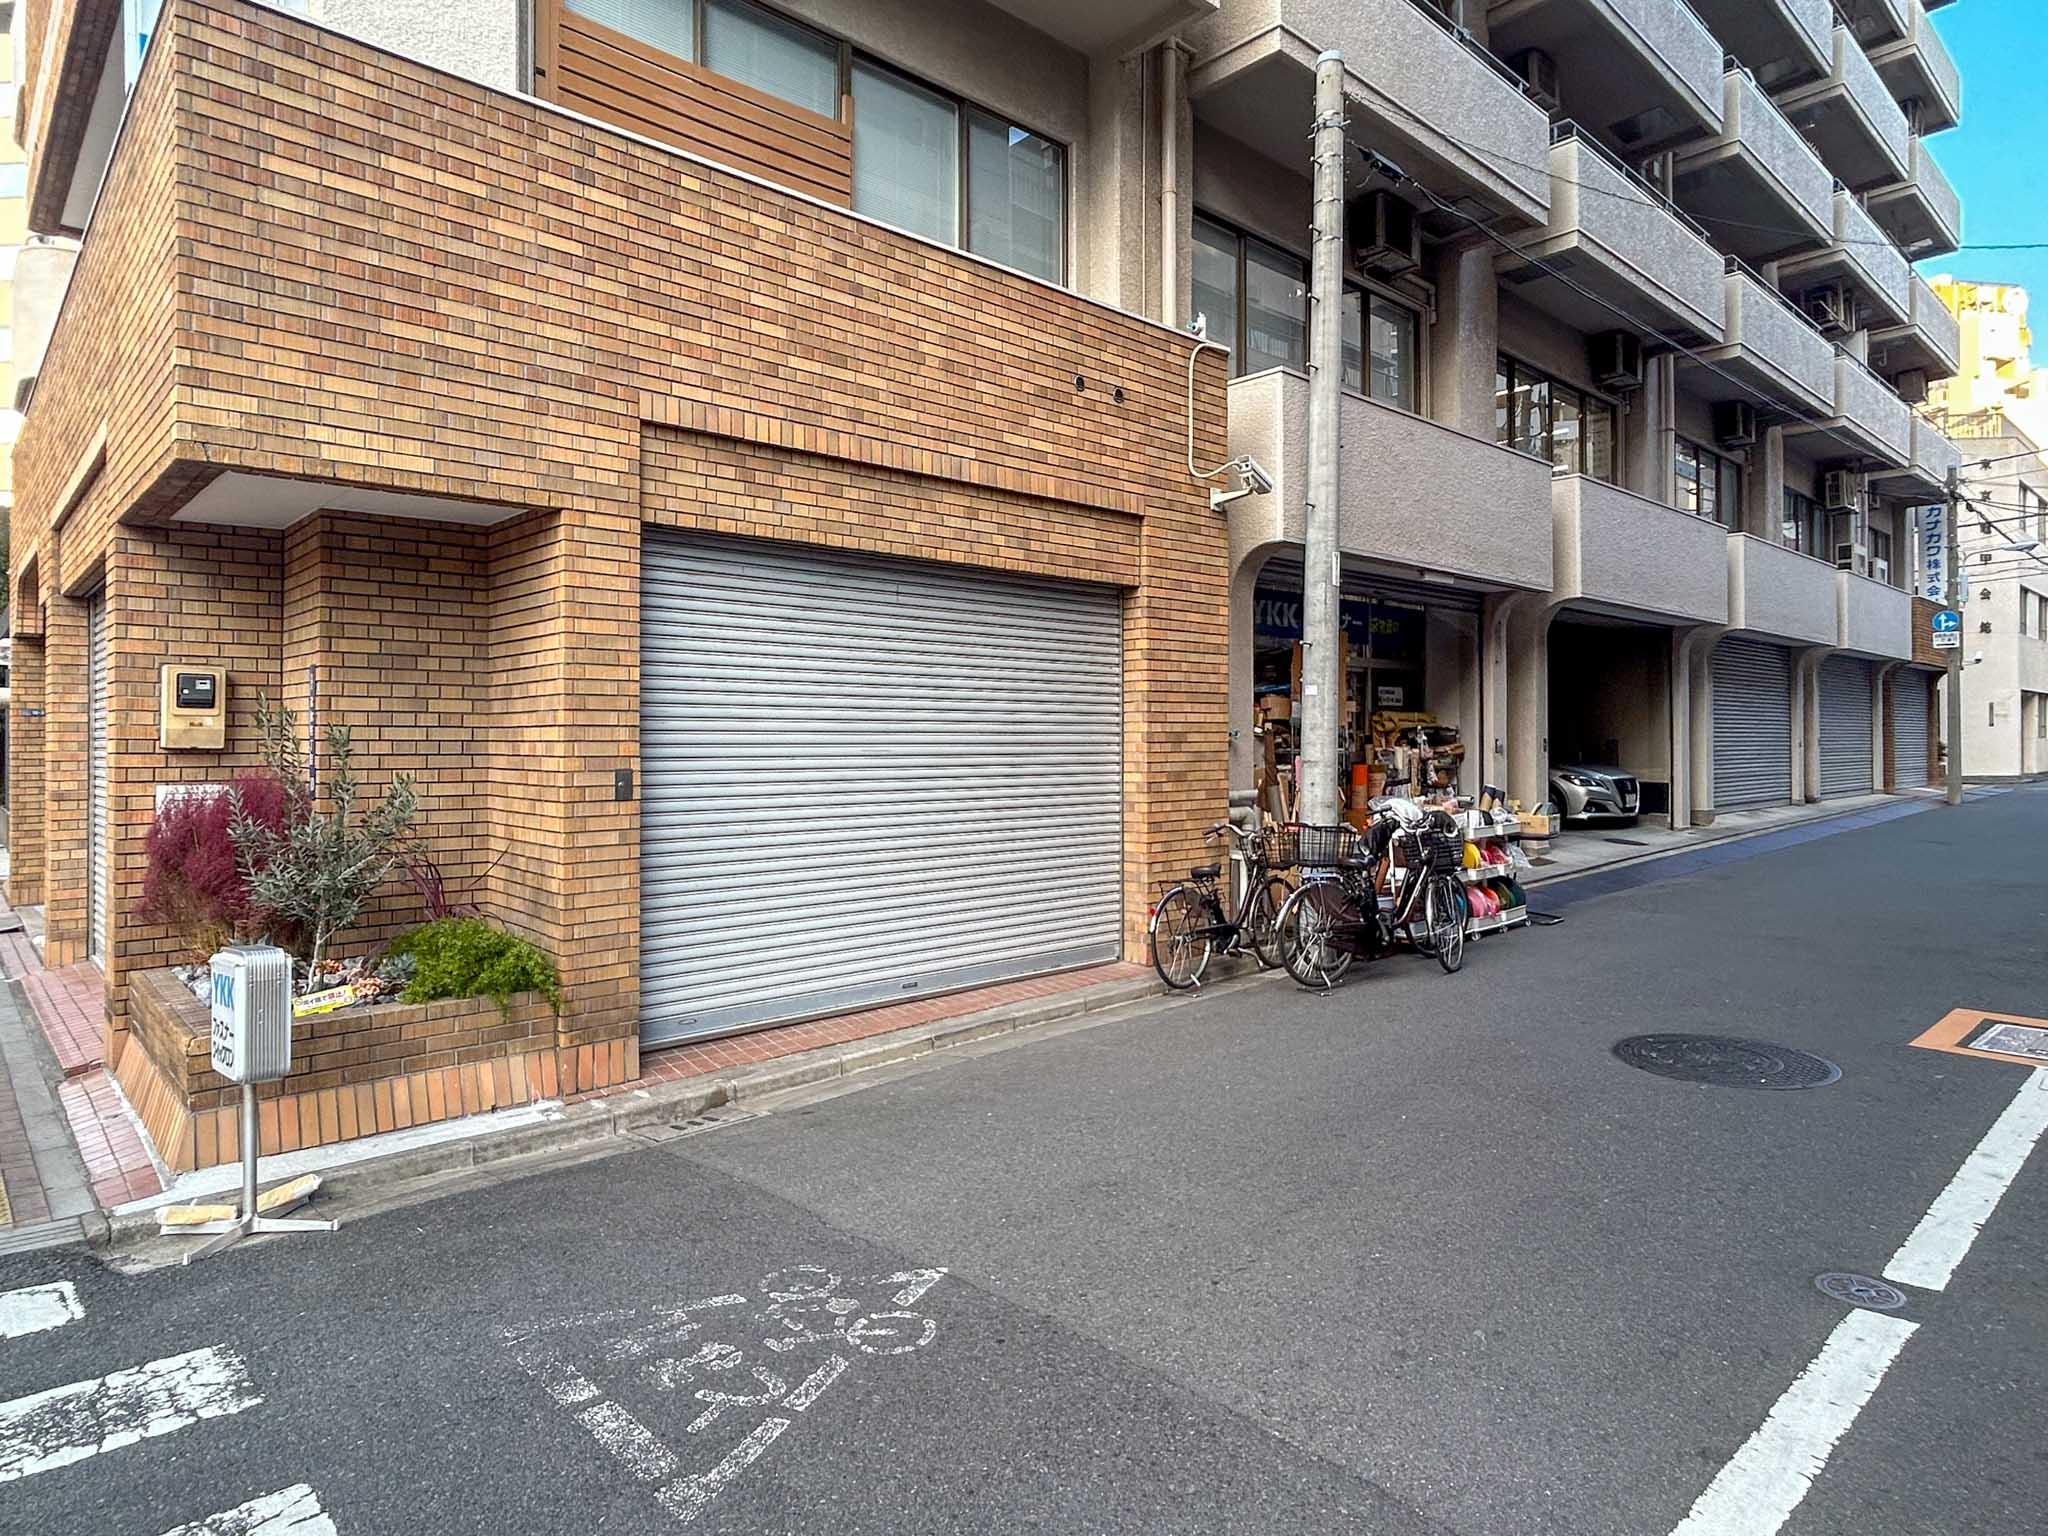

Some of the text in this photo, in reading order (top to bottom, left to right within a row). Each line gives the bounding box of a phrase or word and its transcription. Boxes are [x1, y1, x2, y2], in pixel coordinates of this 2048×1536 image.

[1925, 506, 1943, 601] カナカワ株式会
[213, 972, 235, 1010] YKK
